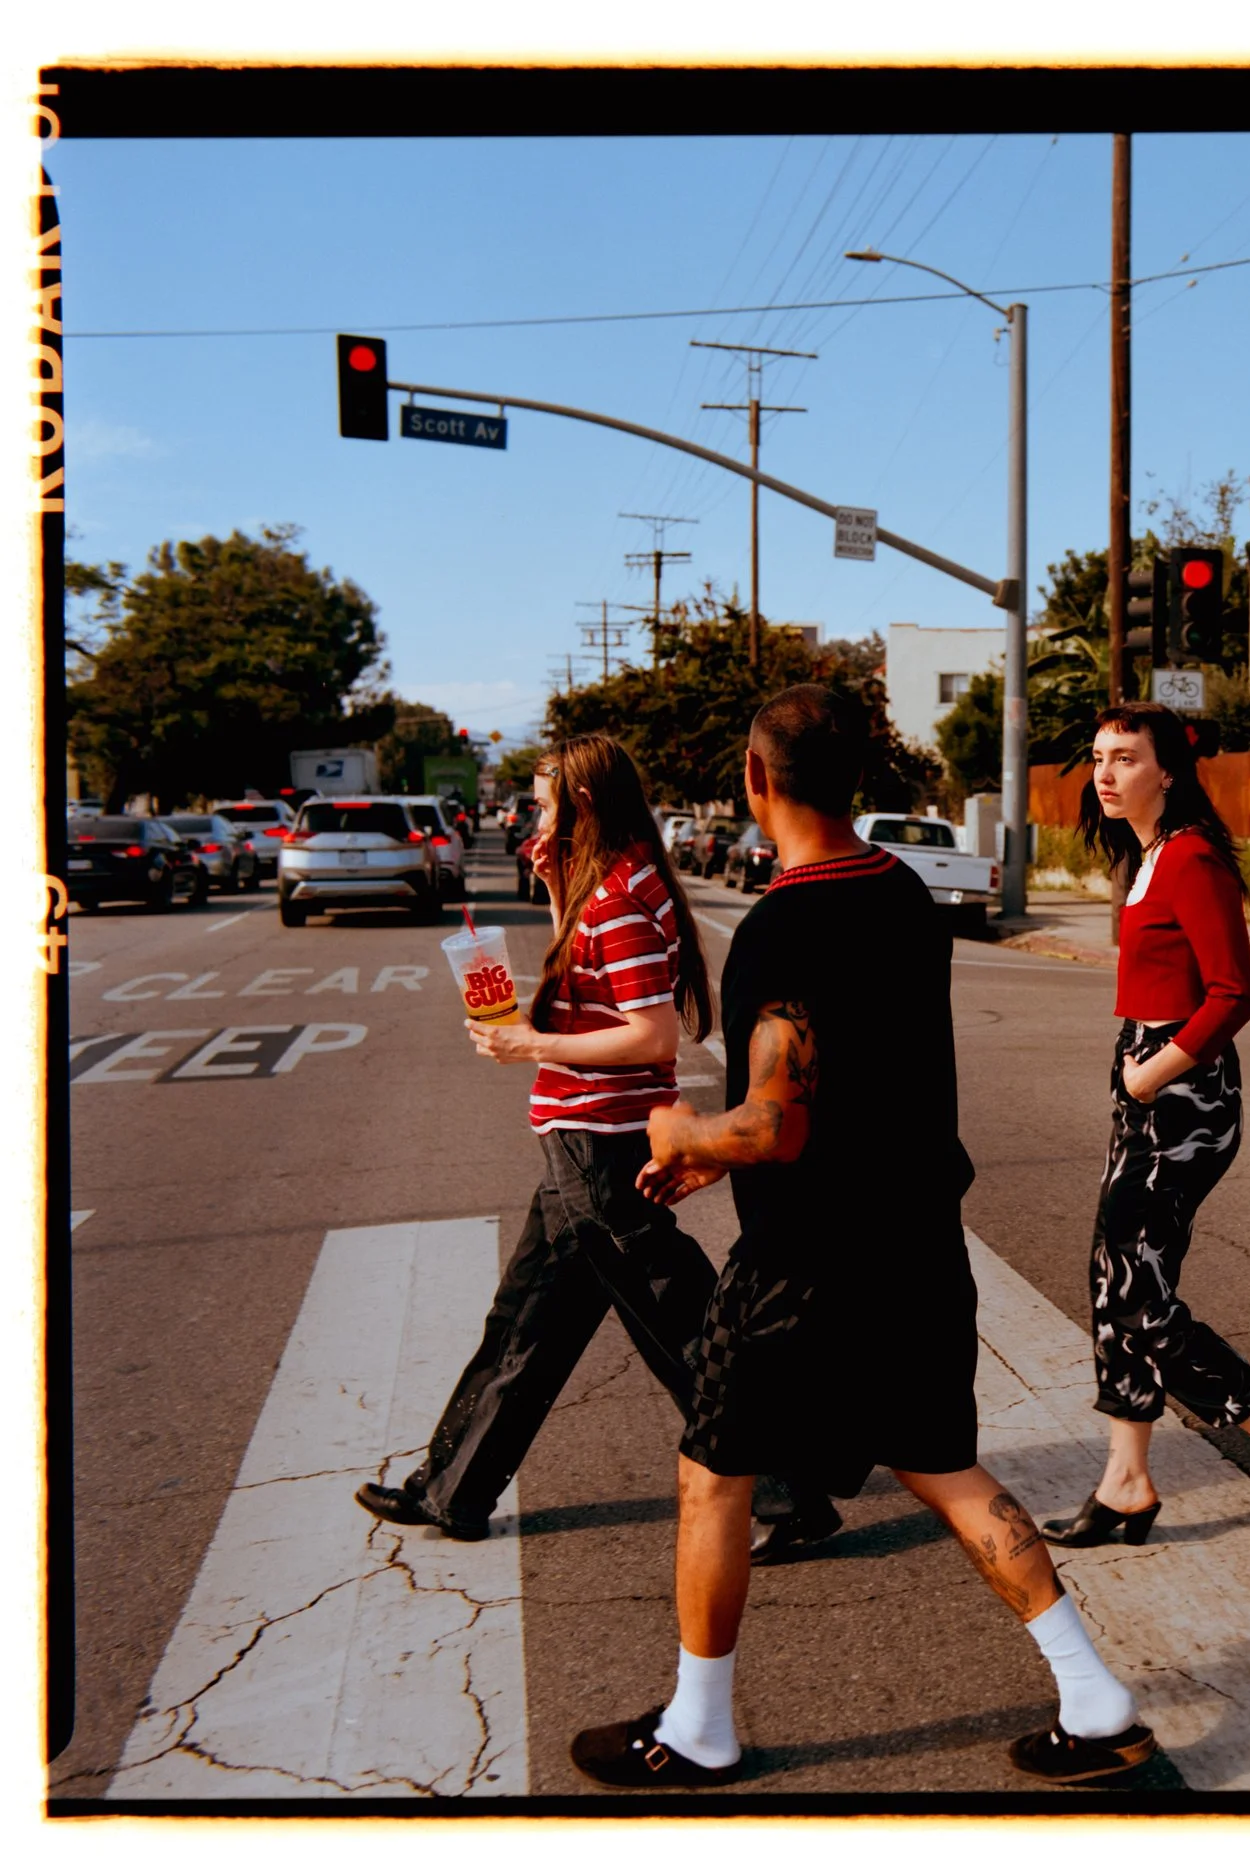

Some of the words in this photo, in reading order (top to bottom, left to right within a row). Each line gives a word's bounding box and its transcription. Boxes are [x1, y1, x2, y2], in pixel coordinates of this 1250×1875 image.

[411, 414, 465, 437] Scott
[475, 421, 500, 440] Av
[838, 530, 873, 545] BLOCK
[102, 965, 430, 1001] CLEAR
[465, 980, 514, 1009] GULP
[69, 1023, 368, 1084] EEP
